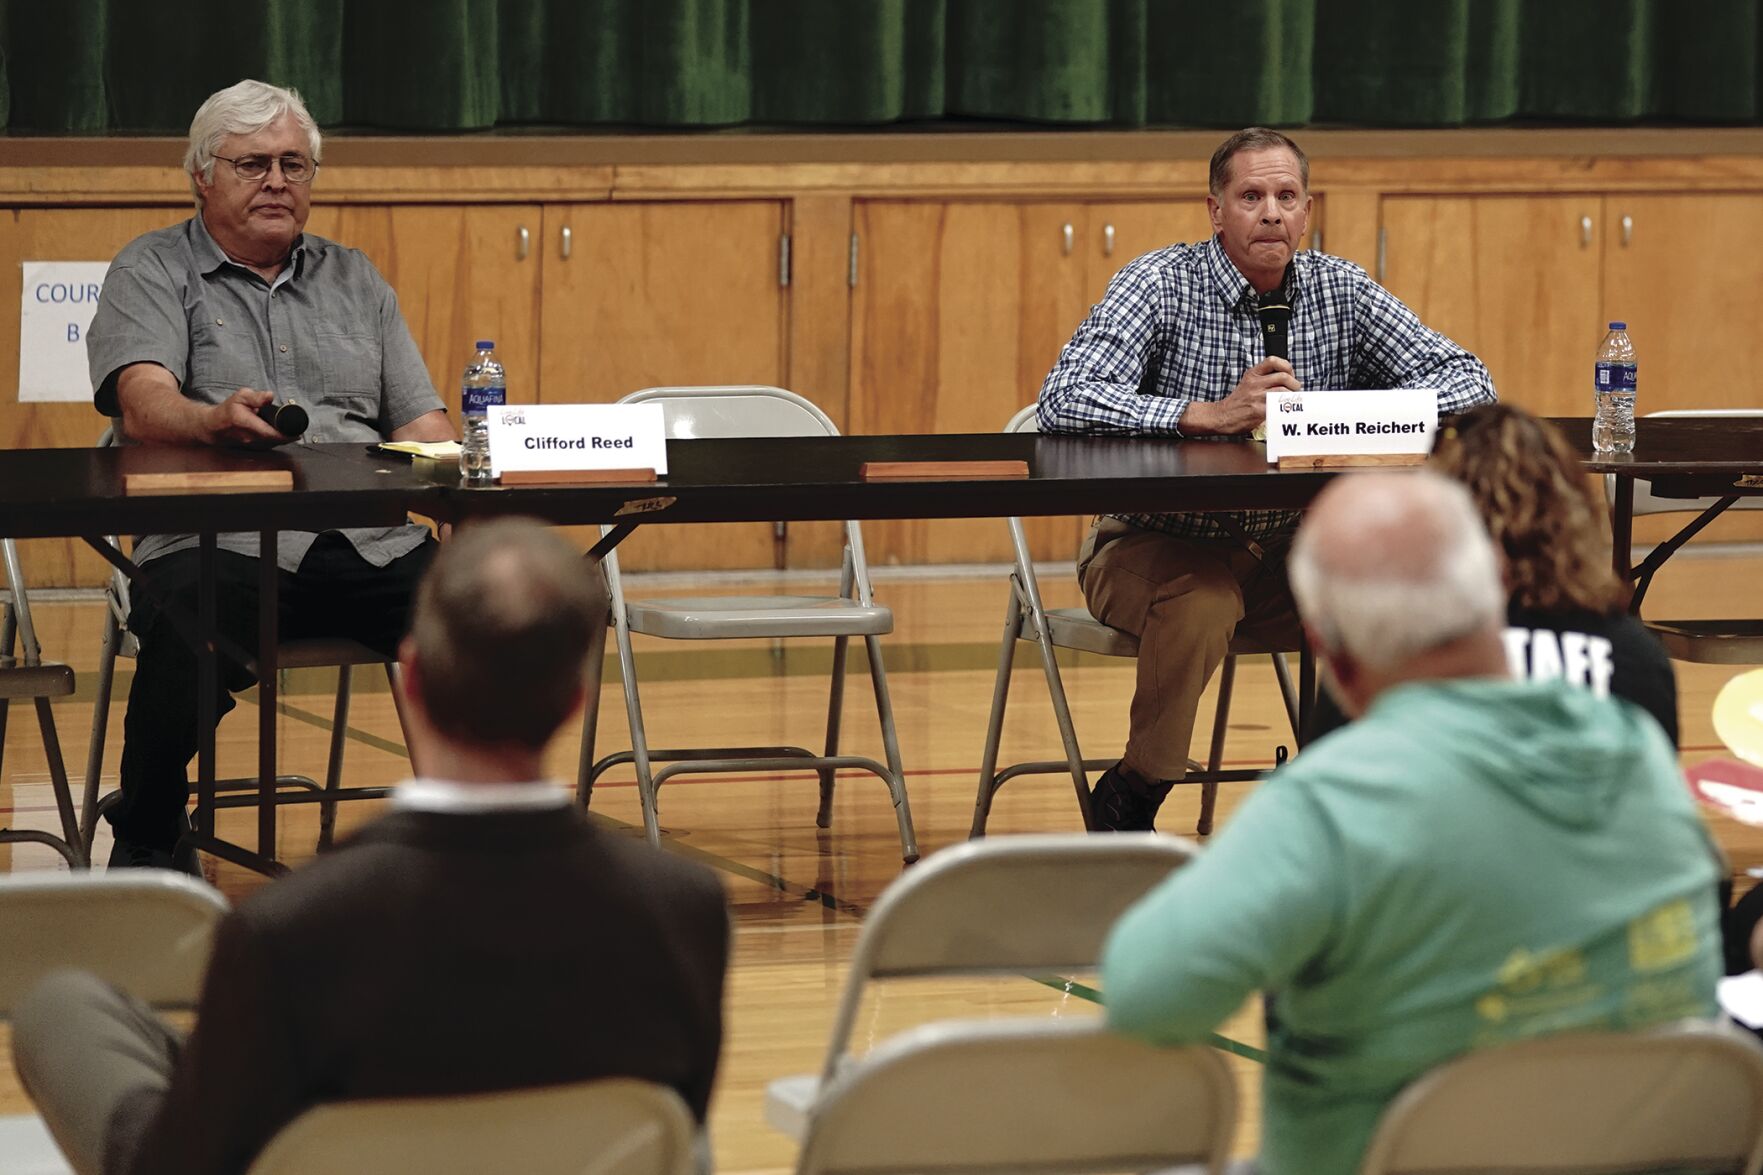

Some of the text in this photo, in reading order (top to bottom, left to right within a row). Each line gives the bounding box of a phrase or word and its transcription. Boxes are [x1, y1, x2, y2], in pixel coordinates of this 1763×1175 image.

[36, 283, 102, 303] COUR
[67, 323, 80, 342] B
[1282, 421, 1425, 436] W. Keith Reichert
[524, 436, 633, 449] Clifford Reed
[1500, 627, 1614, 699] TAFF
